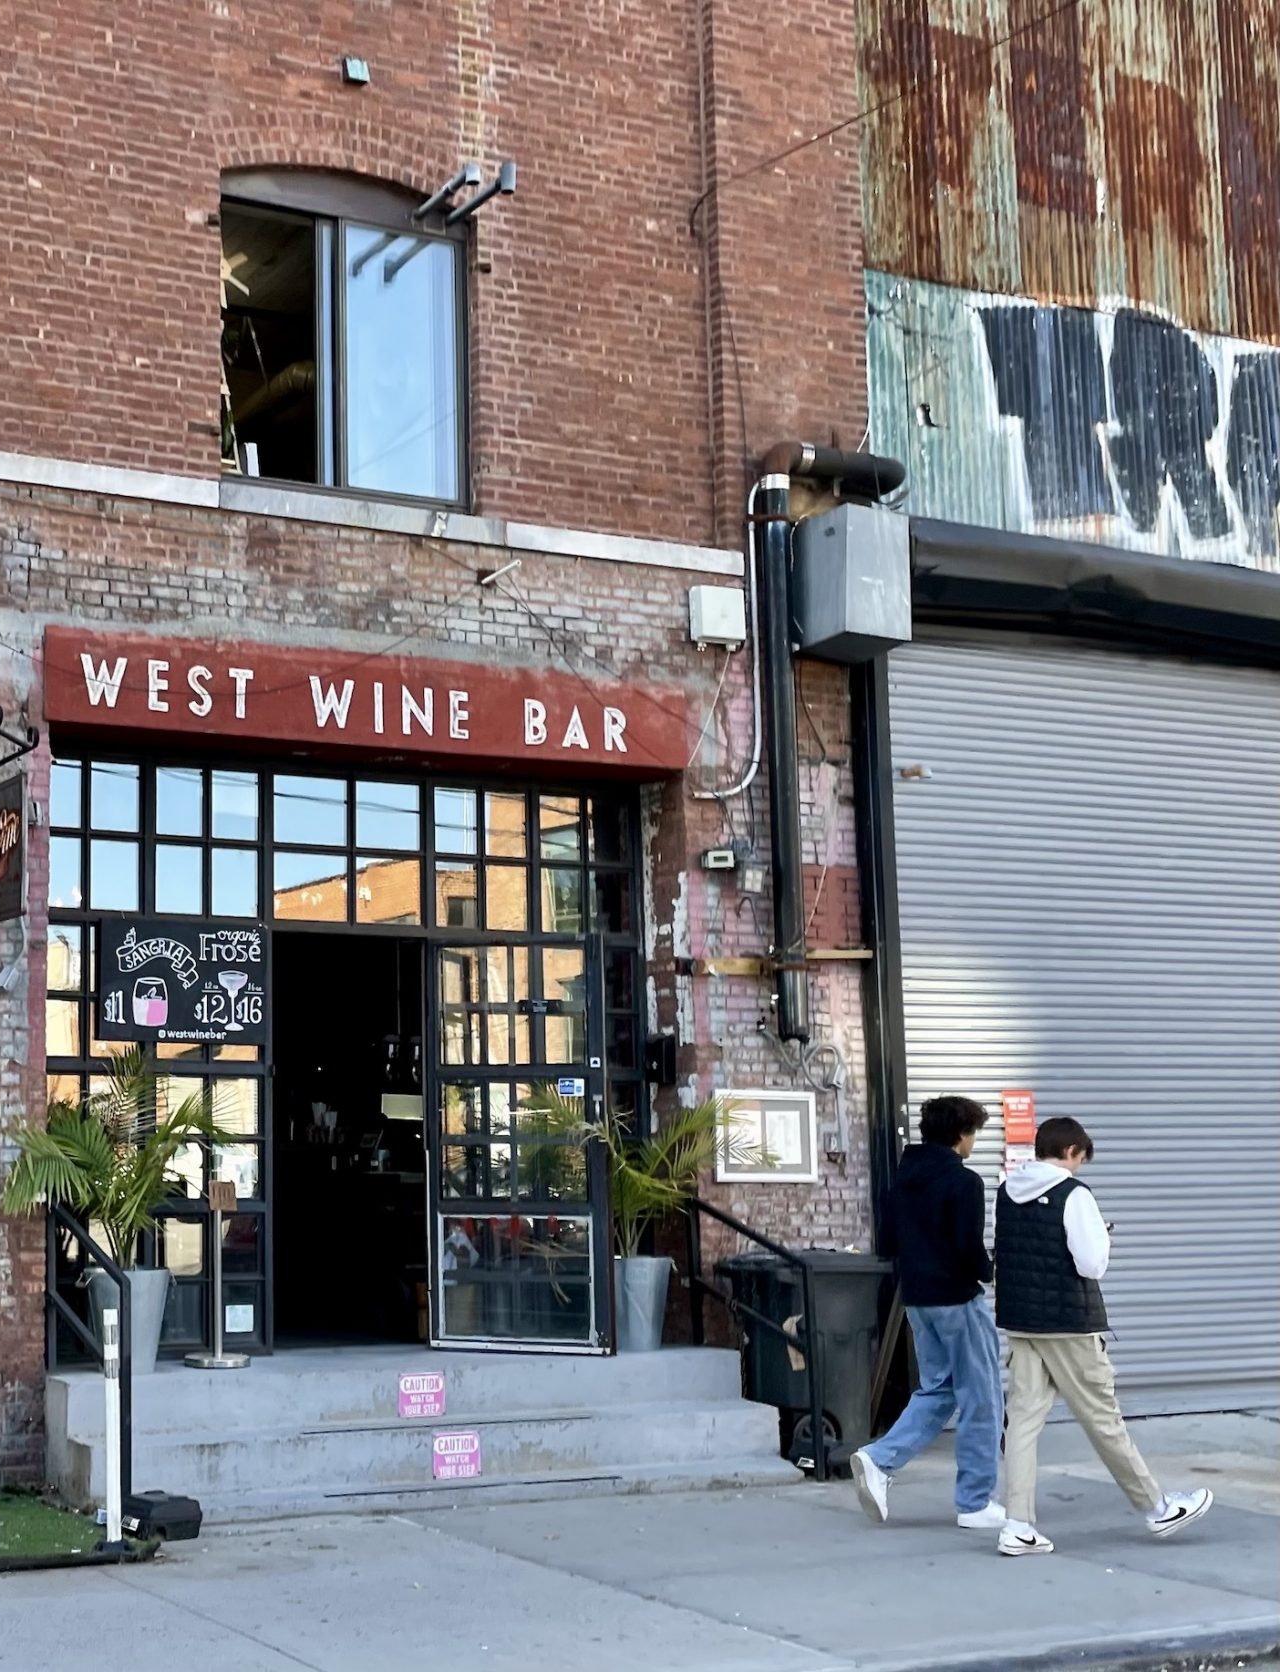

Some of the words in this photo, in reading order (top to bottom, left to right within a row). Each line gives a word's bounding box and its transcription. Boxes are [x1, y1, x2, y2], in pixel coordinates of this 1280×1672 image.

[79, 652, 254, 719] WEST
[308, 675, 470, 740] WINE
[523, 697, 629, 752] BAR
[217, 928, 261, 946] organic
[124, 939, 184, 968] SANGRIA
[193, 994, 228, 1024] $12
[236, 996, 263, 1024] $16
[404, 1377, 440, 1392] CAUTION
[410, 1394, 435, 1404] WATCH
[423, 1404, 440, 1414] STEP
[438, 1437, 475, 1452] CAUTION
[444, 1454, 470, 1465] WATCH
